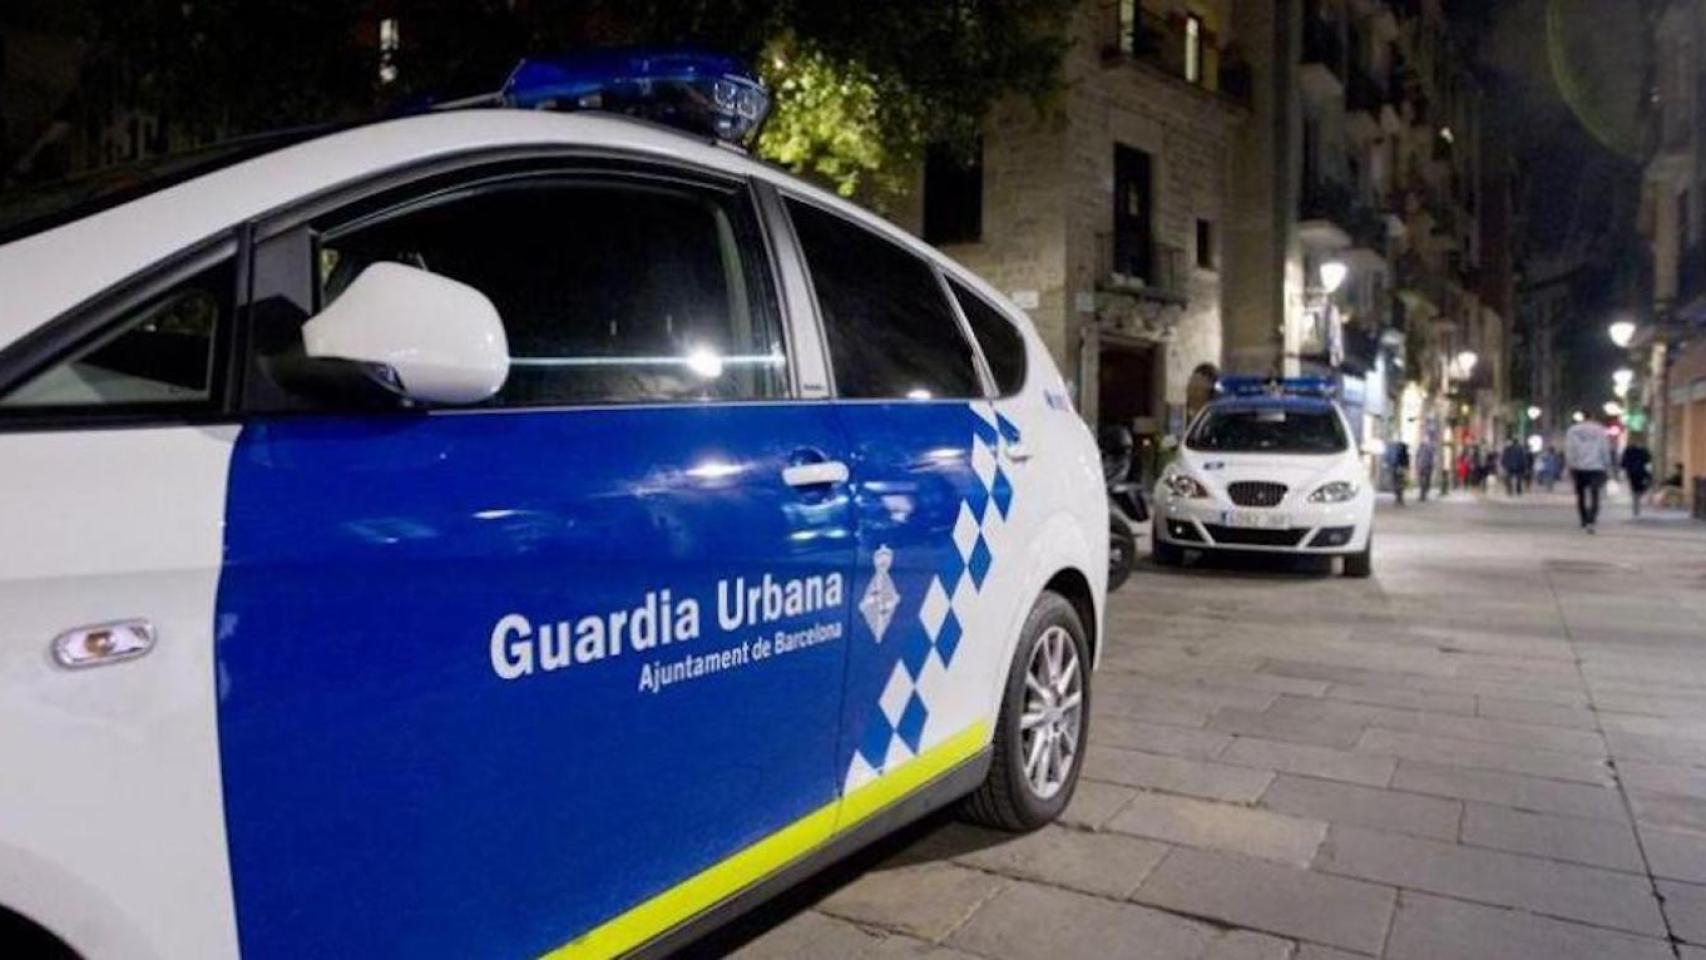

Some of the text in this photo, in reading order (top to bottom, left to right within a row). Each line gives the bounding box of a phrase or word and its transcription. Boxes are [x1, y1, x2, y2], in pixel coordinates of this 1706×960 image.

[490, 571, 843, 680] Guardia Urbana
[638, 621, 842, 693] Ajuntament de Barcelona
